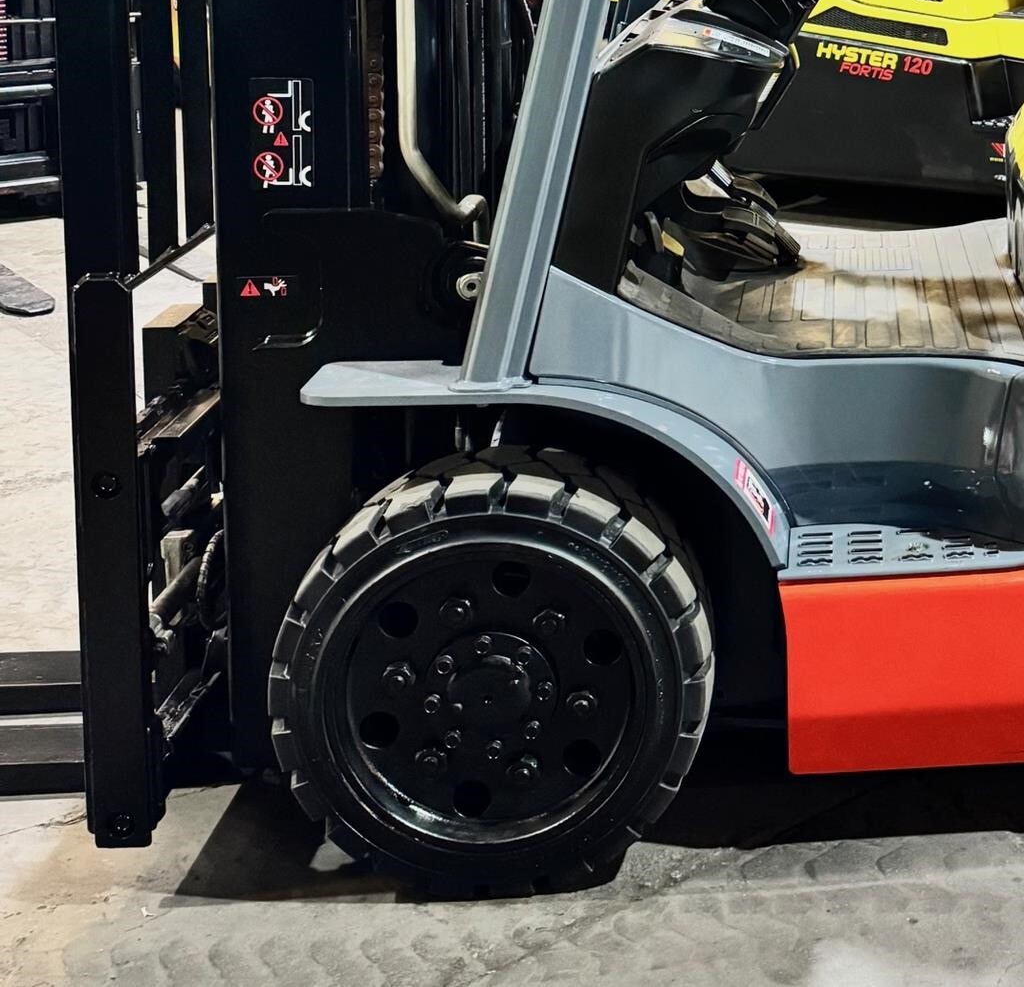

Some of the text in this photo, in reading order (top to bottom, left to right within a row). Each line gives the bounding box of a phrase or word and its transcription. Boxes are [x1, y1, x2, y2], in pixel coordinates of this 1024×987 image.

[816, 41, 933, 76] HYSTER 120
[839, 61, 894, 81] FORTIS
